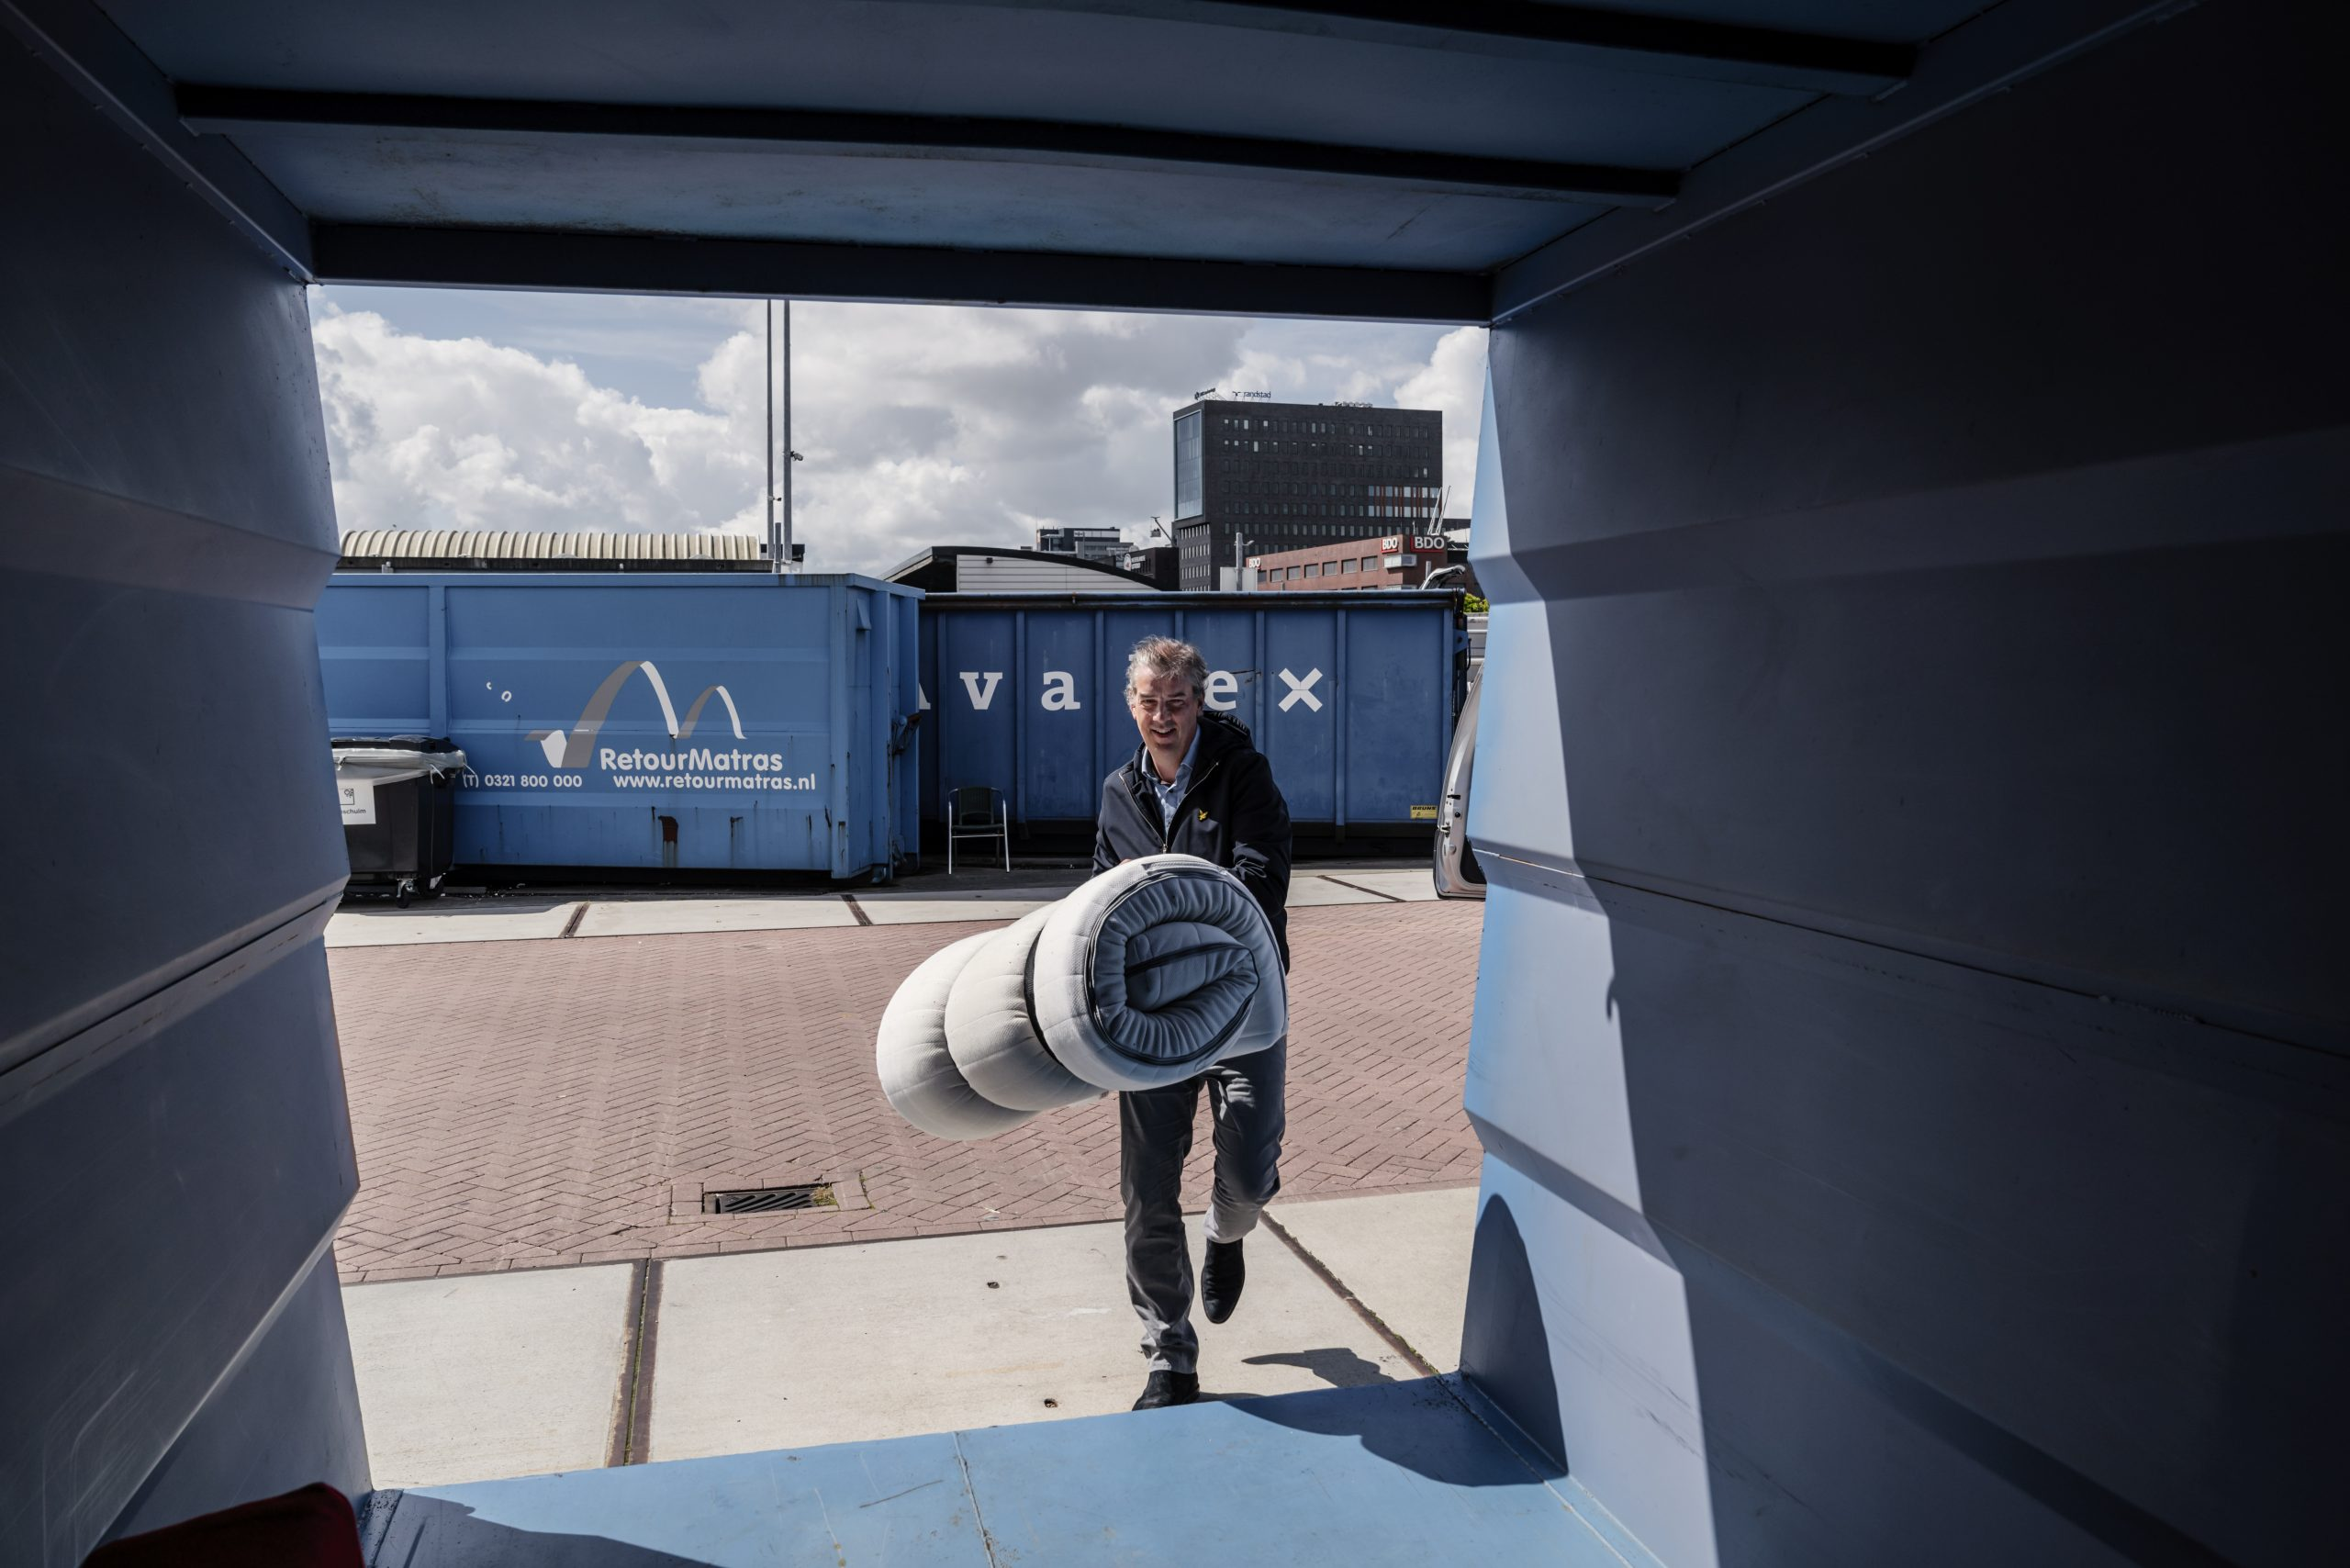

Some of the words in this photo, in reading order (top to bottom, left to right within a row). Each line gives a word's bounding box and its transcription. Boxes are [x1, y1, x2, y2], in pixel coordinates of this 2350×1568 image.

[1382, 537, 1398, 550] BDO
[1415, 536, 1445, 549] BDO
[1249, 557, 1261, 568] BDO
[599, 748, 783, 771] RetourMatras
[485, 774, 515, 787] 0321
[520, 775, 548, 788] 800
[553, 775, 584, 788] 000
[613, 772, 816, 790] www.retourmatras.nl
